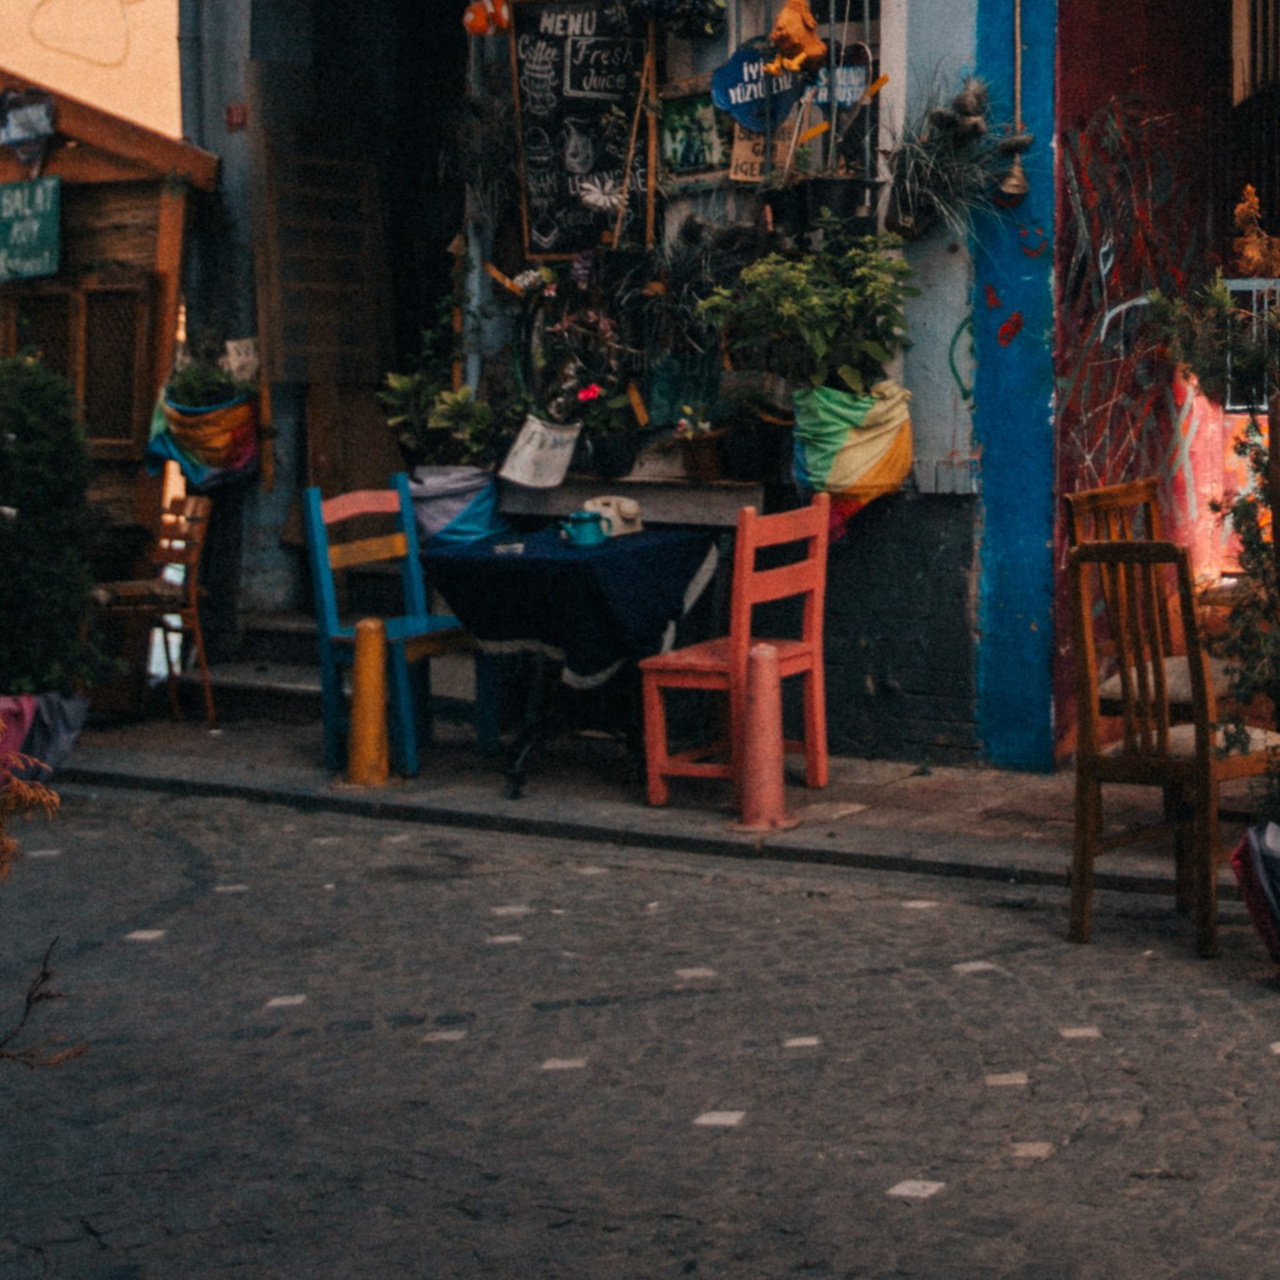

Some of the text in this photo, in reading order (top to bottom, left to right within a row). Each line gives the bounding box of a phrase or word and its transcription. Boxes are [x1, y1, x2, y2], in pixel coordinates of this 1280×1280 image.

[540, 10, 596, 36] MENU
[573, 39, 636, 64] Fresh
[582, 68, 626, 90] Juice
